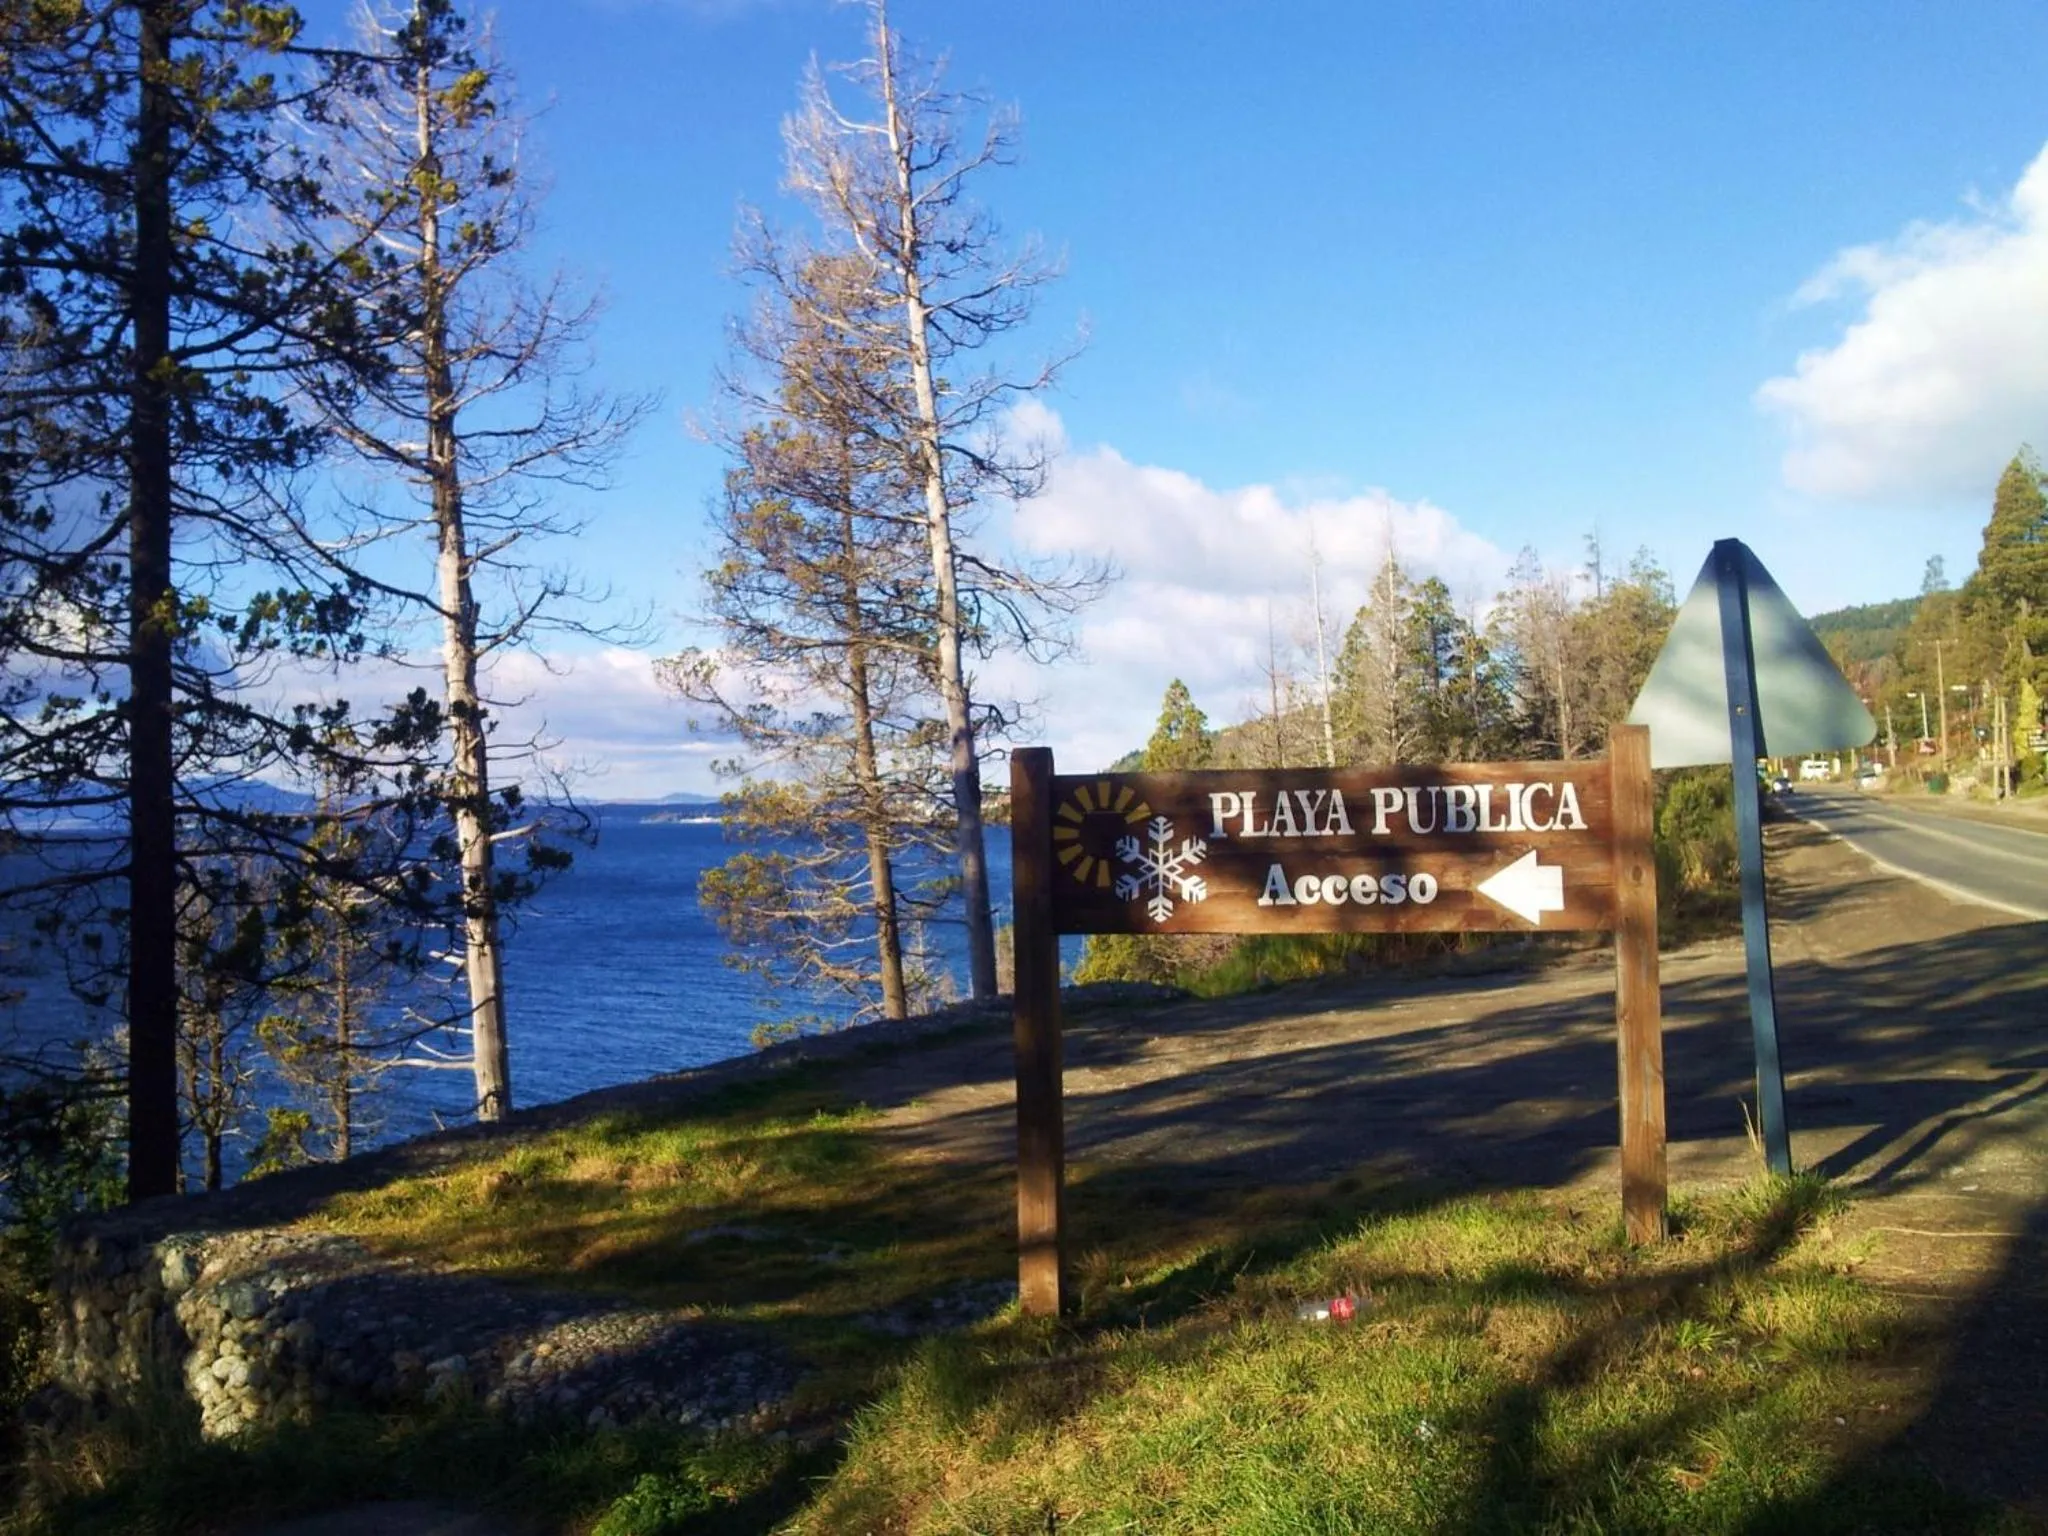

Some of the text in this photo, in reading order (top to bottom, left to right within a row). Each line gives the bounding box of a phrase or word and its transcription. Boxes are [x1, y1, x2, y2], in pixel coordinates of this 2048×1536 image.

[1208, 782, 1588, 838] PLAYA PUBLICA
[1258, 863, 1438, 906] Acceso
